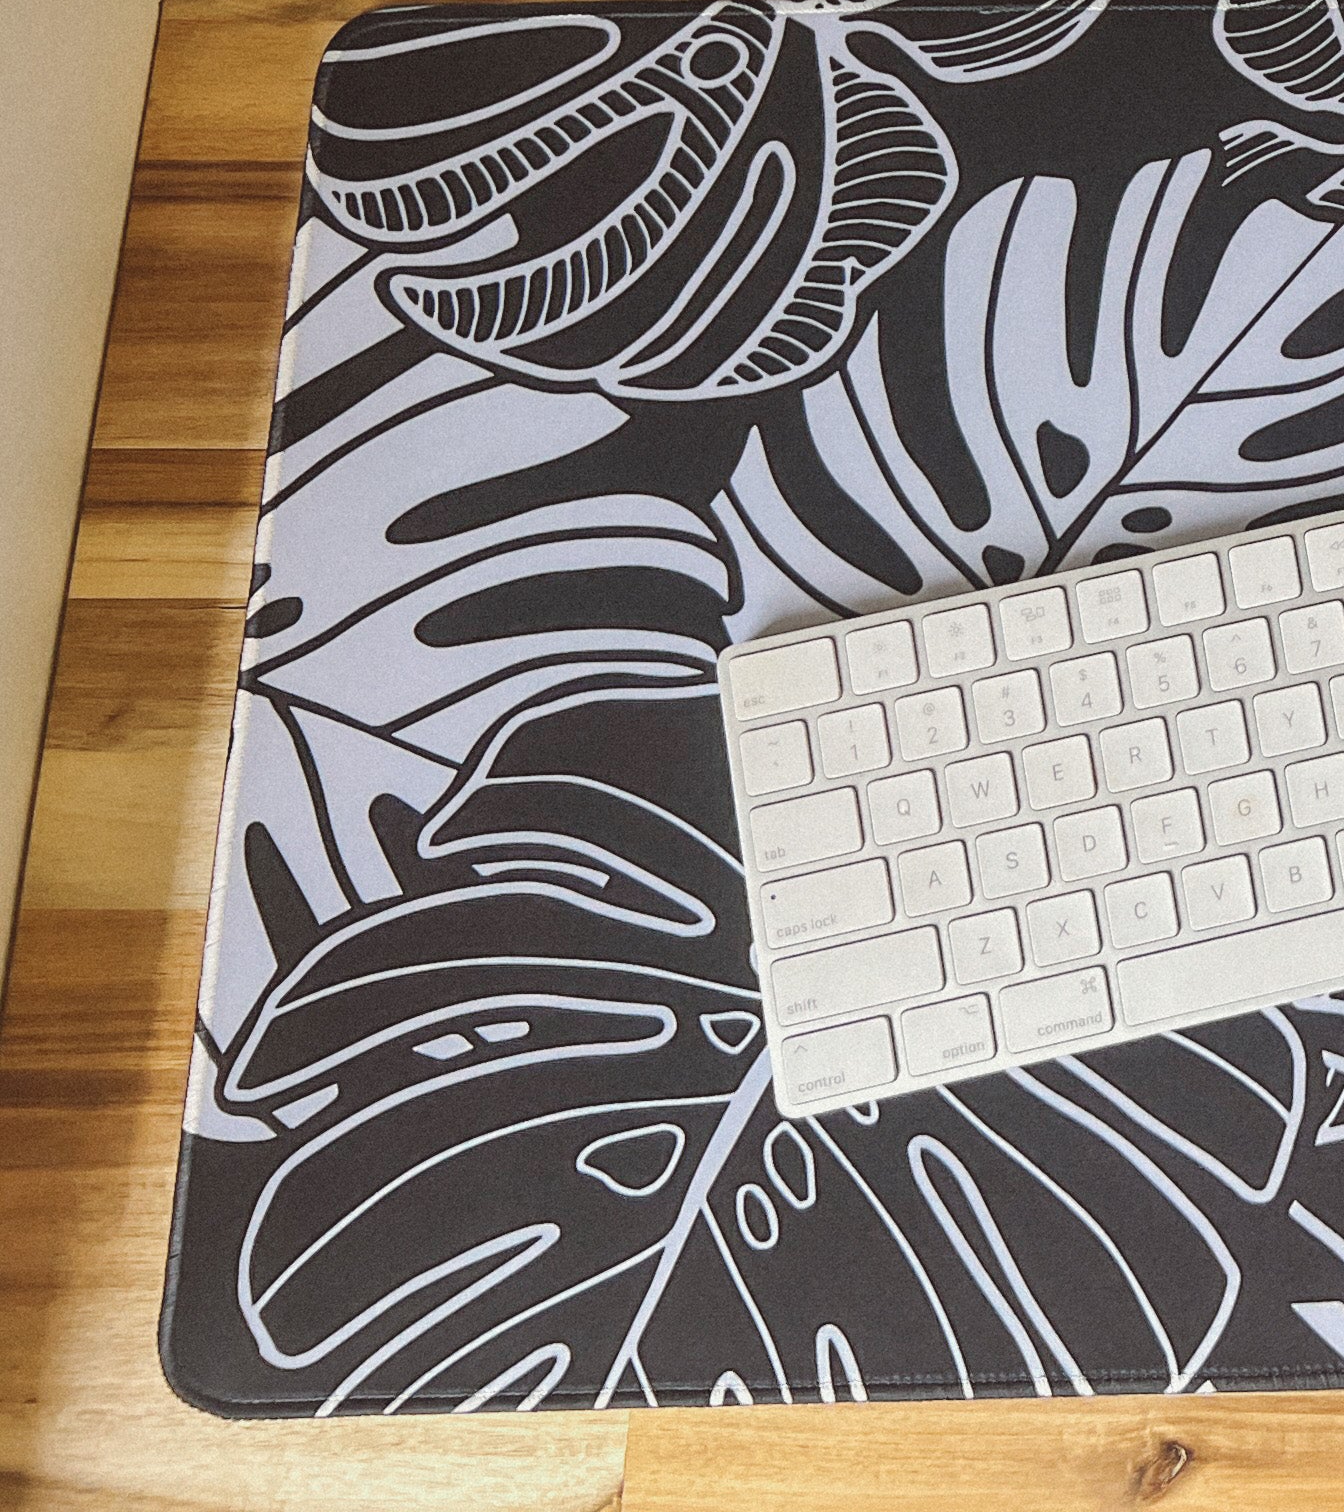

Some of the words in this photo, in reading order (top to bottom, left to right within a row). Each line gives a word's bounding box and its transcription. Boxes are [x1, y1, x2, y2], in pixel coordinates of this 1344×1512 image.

[1310, 639, 1322, 658] 7
[1232, 657, 1248, 676] 6
[1157, 673, 1171, 693] 5
[742, 695, 766, 709] esc
[1080, 692, 1093, 709] 4
[1002, 708, 1016, 728] 3
[1282, 710, 1295, 729] Y
[926, 726, 939, 746] 2
[1205, 727, 1218, 747] T
[849, 743, 859, 761] 1
[1128, 745, 1143, 765] R
[1051, 762, 1064, 782] E
[970, 780, 990, 800] W
[1314, 781, 1330, 800] H
[895, 797, 912, 817] Q
[1236, 798, 1253, 818] G
[1160, 816, 1172, 835] F
[763, 846, 787, 861] tab
[1081, 834, 1098, 854] D
[1004, 850, 1020, 871] S
[927, 869, 942, 889] A
[1287, 865, 1303, 885] B
[1209, 882, 1225, 901] V
[1133, 900, 1149, 921] C
[775, 922, 808, 939] caps
[810, 913, 838, 930] lock
[1056, 919, 1070, 938] X
[978, 936, 992, 956] Z
[786, 997, 818, 1016] shift
[1036, 1011, 1103, 1037] command
[941, 1041, 986, 1060] option
[797, 1070, 846, 1094] control
